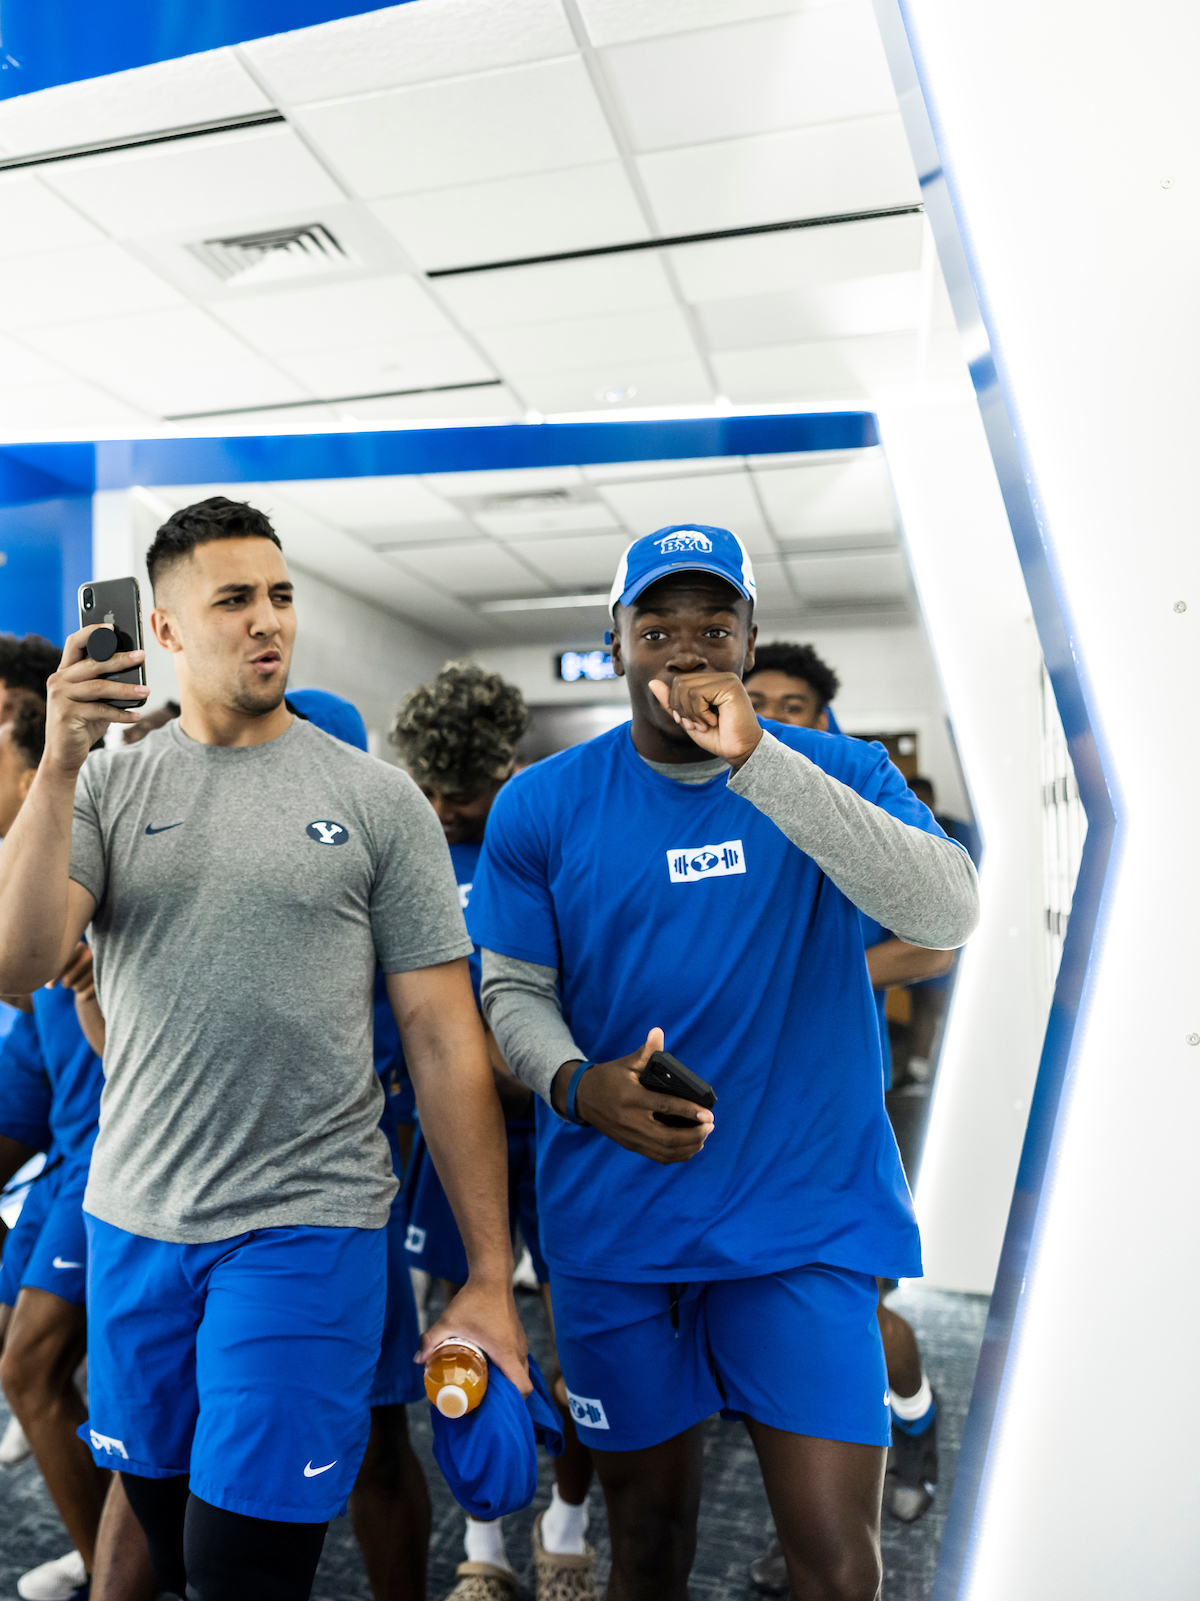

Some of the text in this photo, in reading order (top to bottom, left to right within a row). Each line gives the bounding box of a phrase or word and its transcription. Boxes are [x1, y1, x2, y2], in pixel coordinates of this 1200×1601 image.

[661, 539, 713, 555] BYU
[311, 821, 343, 844] Y
[694, 853, 715, 871] Y
